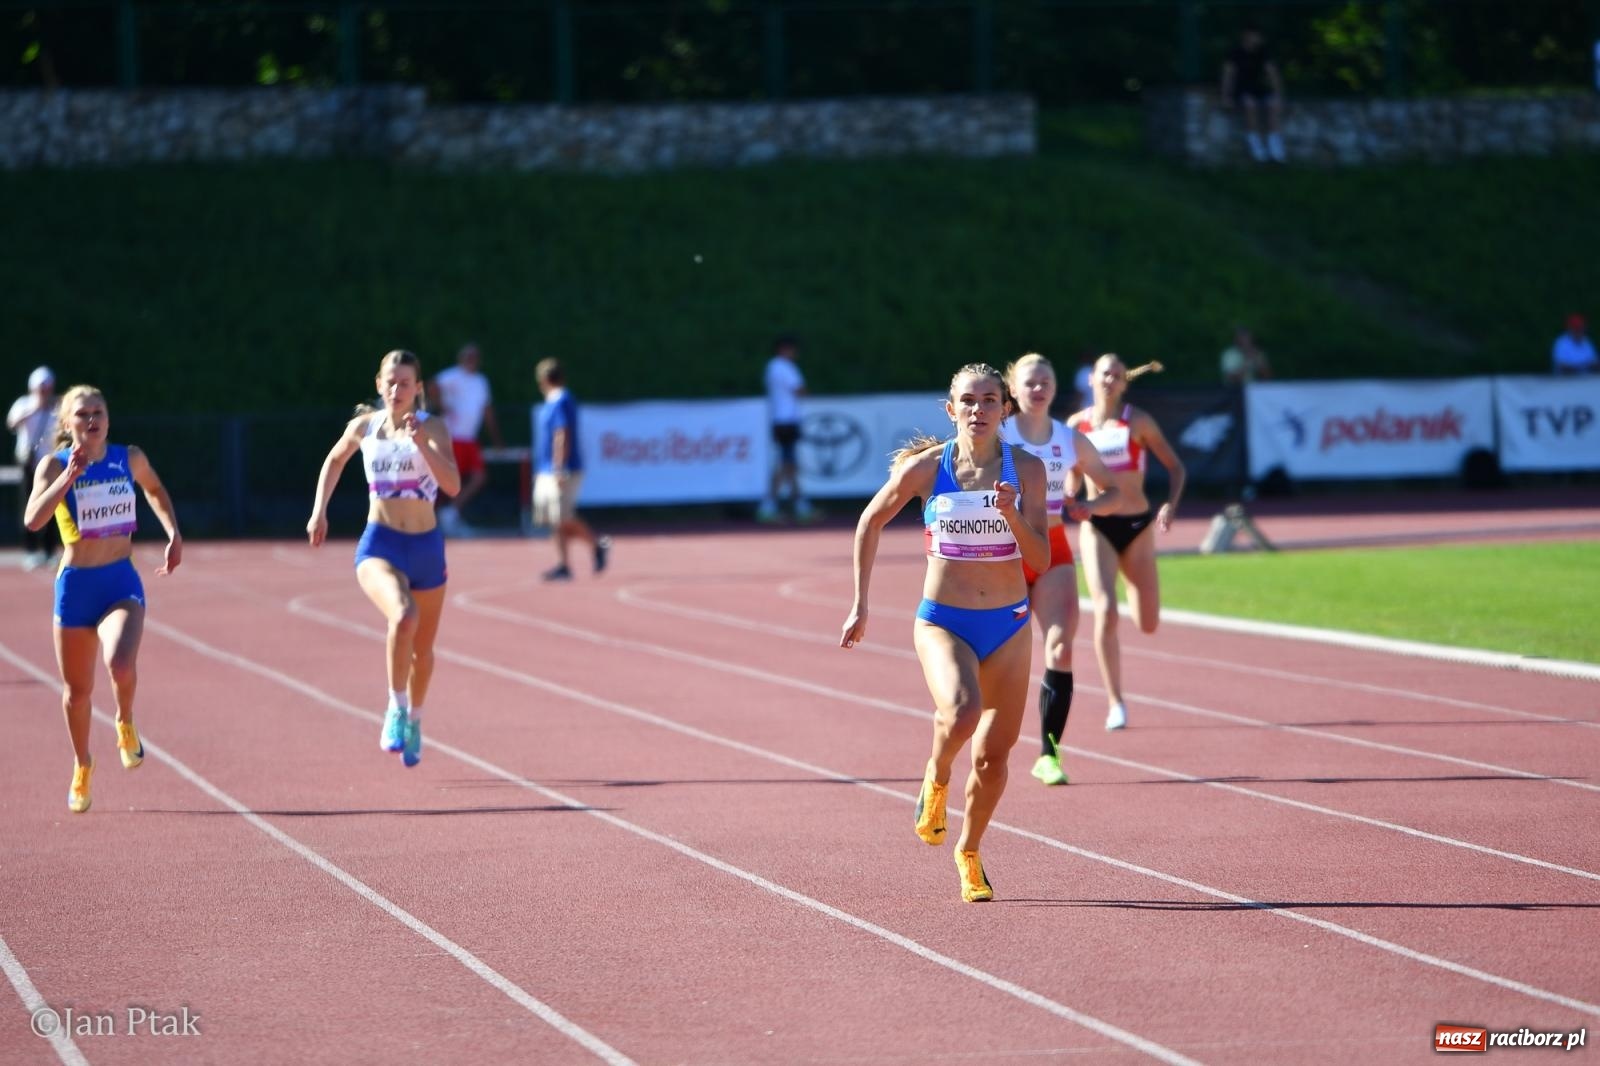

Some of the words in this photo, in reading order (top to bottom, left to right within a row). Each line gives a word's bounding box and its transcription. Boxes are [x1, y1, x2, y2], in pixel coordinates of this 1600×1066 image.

[1321, 405, 1466, 449] polanik
[1521, 406, 1593, 437] TVP
[1050, 461, 1063, 472] 39
[109, 484, 129, 496] 406
[82, 501, 132, 521] HYRYCH
[939, 519, 1011, 535] PISCHNOTHOV
